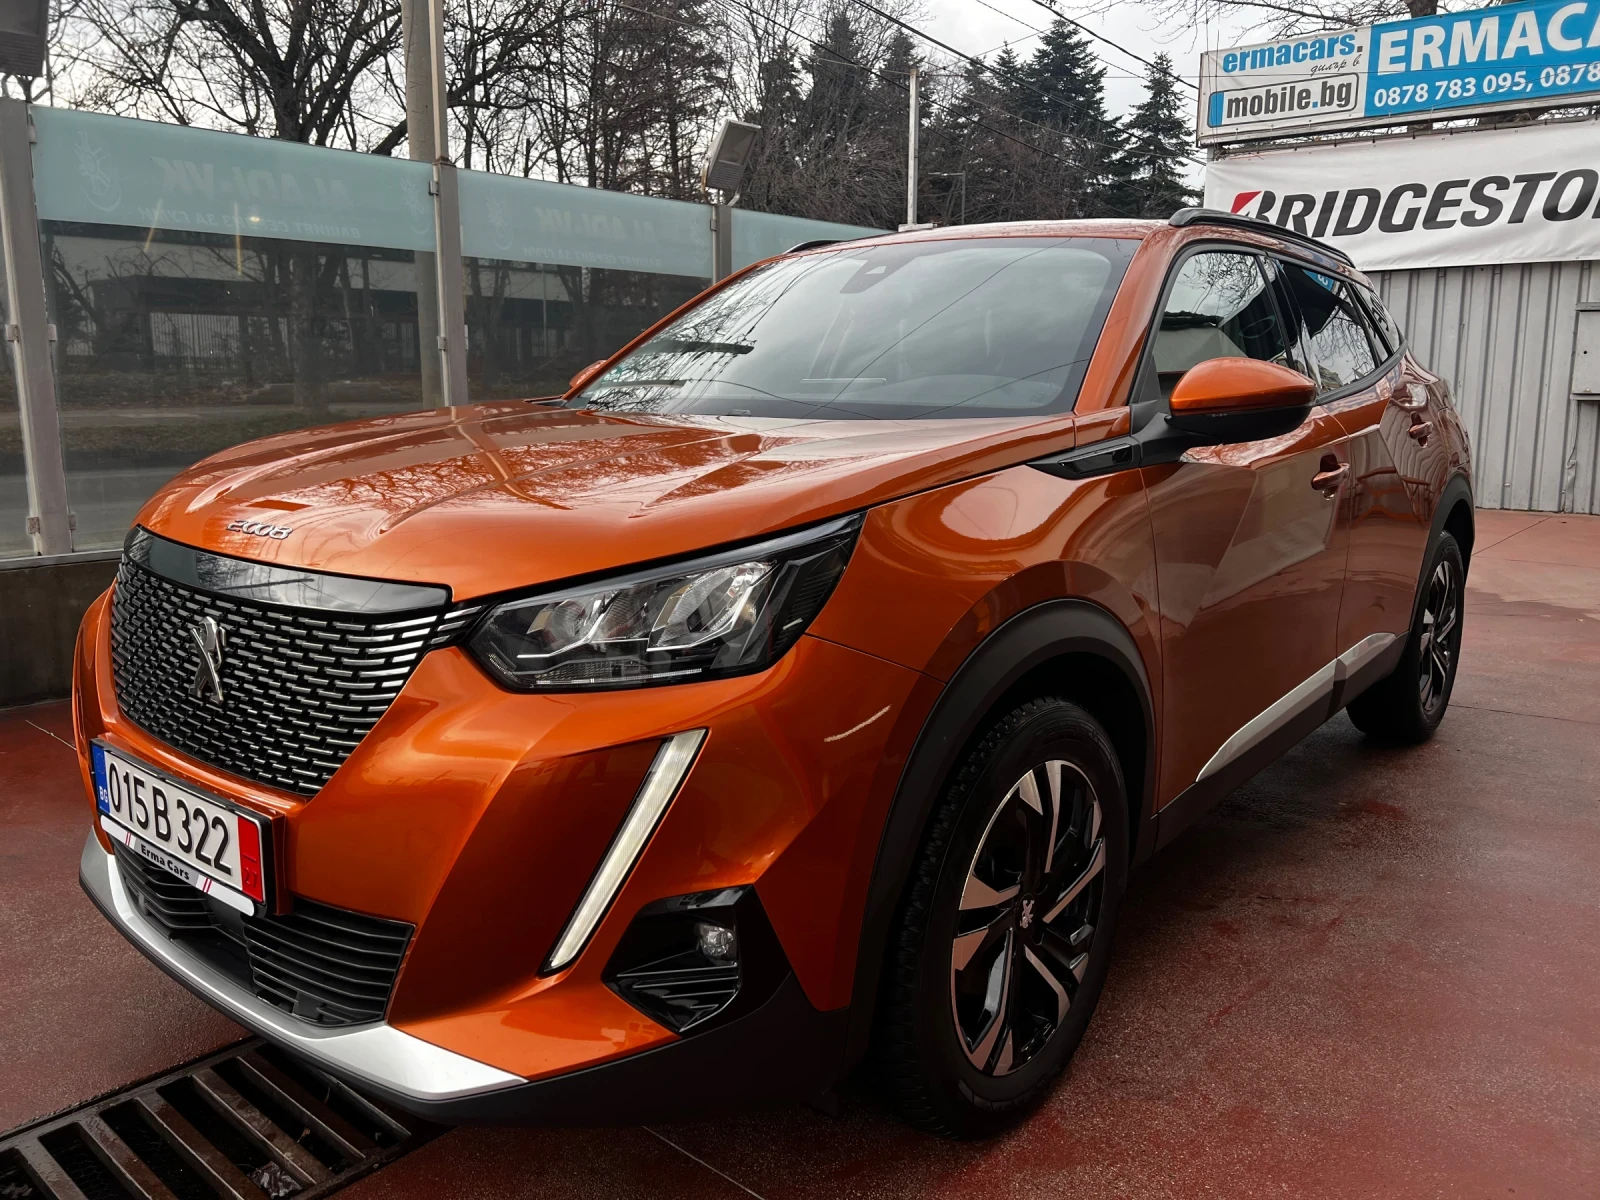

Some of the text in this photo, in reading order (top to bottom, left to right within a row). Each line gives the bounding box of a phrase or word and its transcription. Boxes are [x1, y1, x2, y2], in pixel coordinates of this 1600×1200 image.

[1226, 81, 1352, 118] mobile.bg
[1374, 60, 1600, 108] 0878 783 095, 0878
[1231, 168, 1600, 238] BRIDGESTO
[226, 519, 293, 541] 2008
[99, 785, 109, 803] BG
[140, 843, 190, 881] Erma Cars
